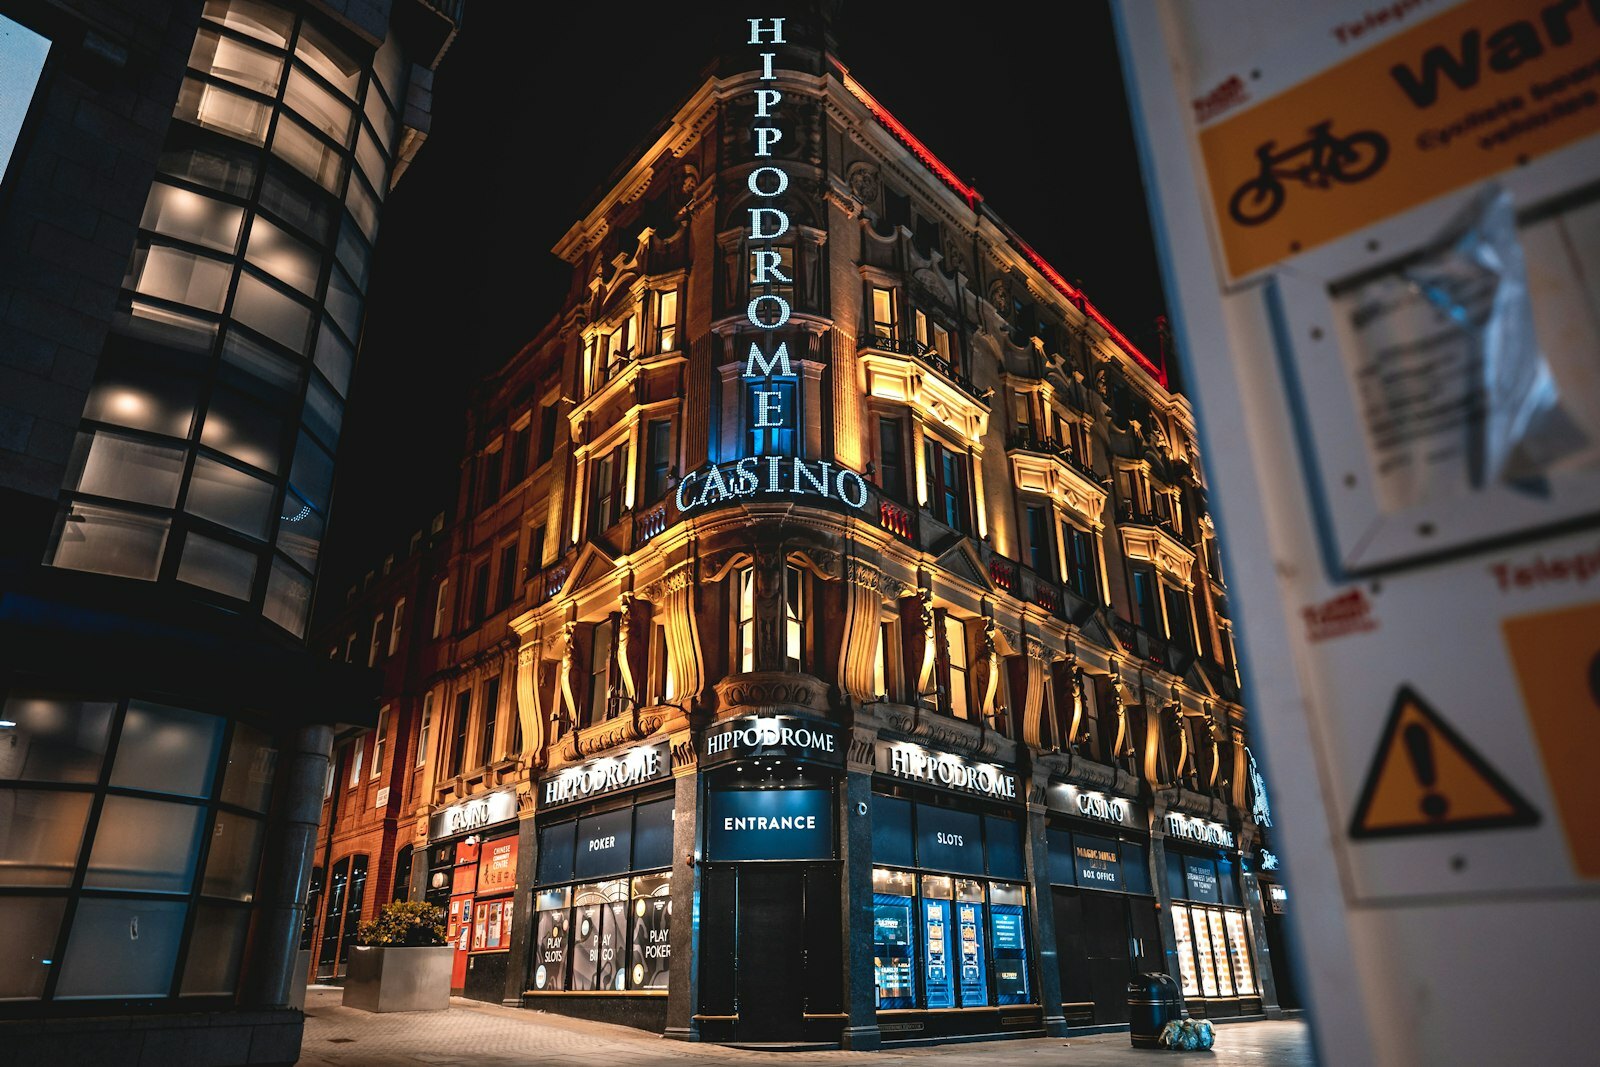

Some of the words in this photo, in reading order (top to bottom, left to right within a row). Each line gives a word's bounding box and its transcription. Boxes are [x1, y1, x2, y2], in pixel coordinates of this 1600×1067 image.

[742, 17, 797, 428] HIPPODROME
[675, 455, 869, 513] CASINO
[706, 727, 835, 756] HIPPODROME
[545, 748, 661, 804] HIPPODROME
[890, 746, 1016, 799] HIPPODROME
[1076, 793, 1124, 822] CASINO
[452, 803, 491, 832] CASINO
[724, 815, 816, 831] ENTRANCE
[937, 831, 964, 847] SLOTS
[1170, 815, 1234, 848] HIPPODROME
[588, 835, 615, 852] POKER
[1083, 869, 1095, 879] BOX
[1096, 871, 1115, 882] OFFICE
[547, 936, 562, 949] PLAY
[593, 934, 611, 947] PAY
[649, 928, 670, 943] PLAY
[544, 950, 562, 963] SLOTS
[645, 944, 671, 959] POKER
